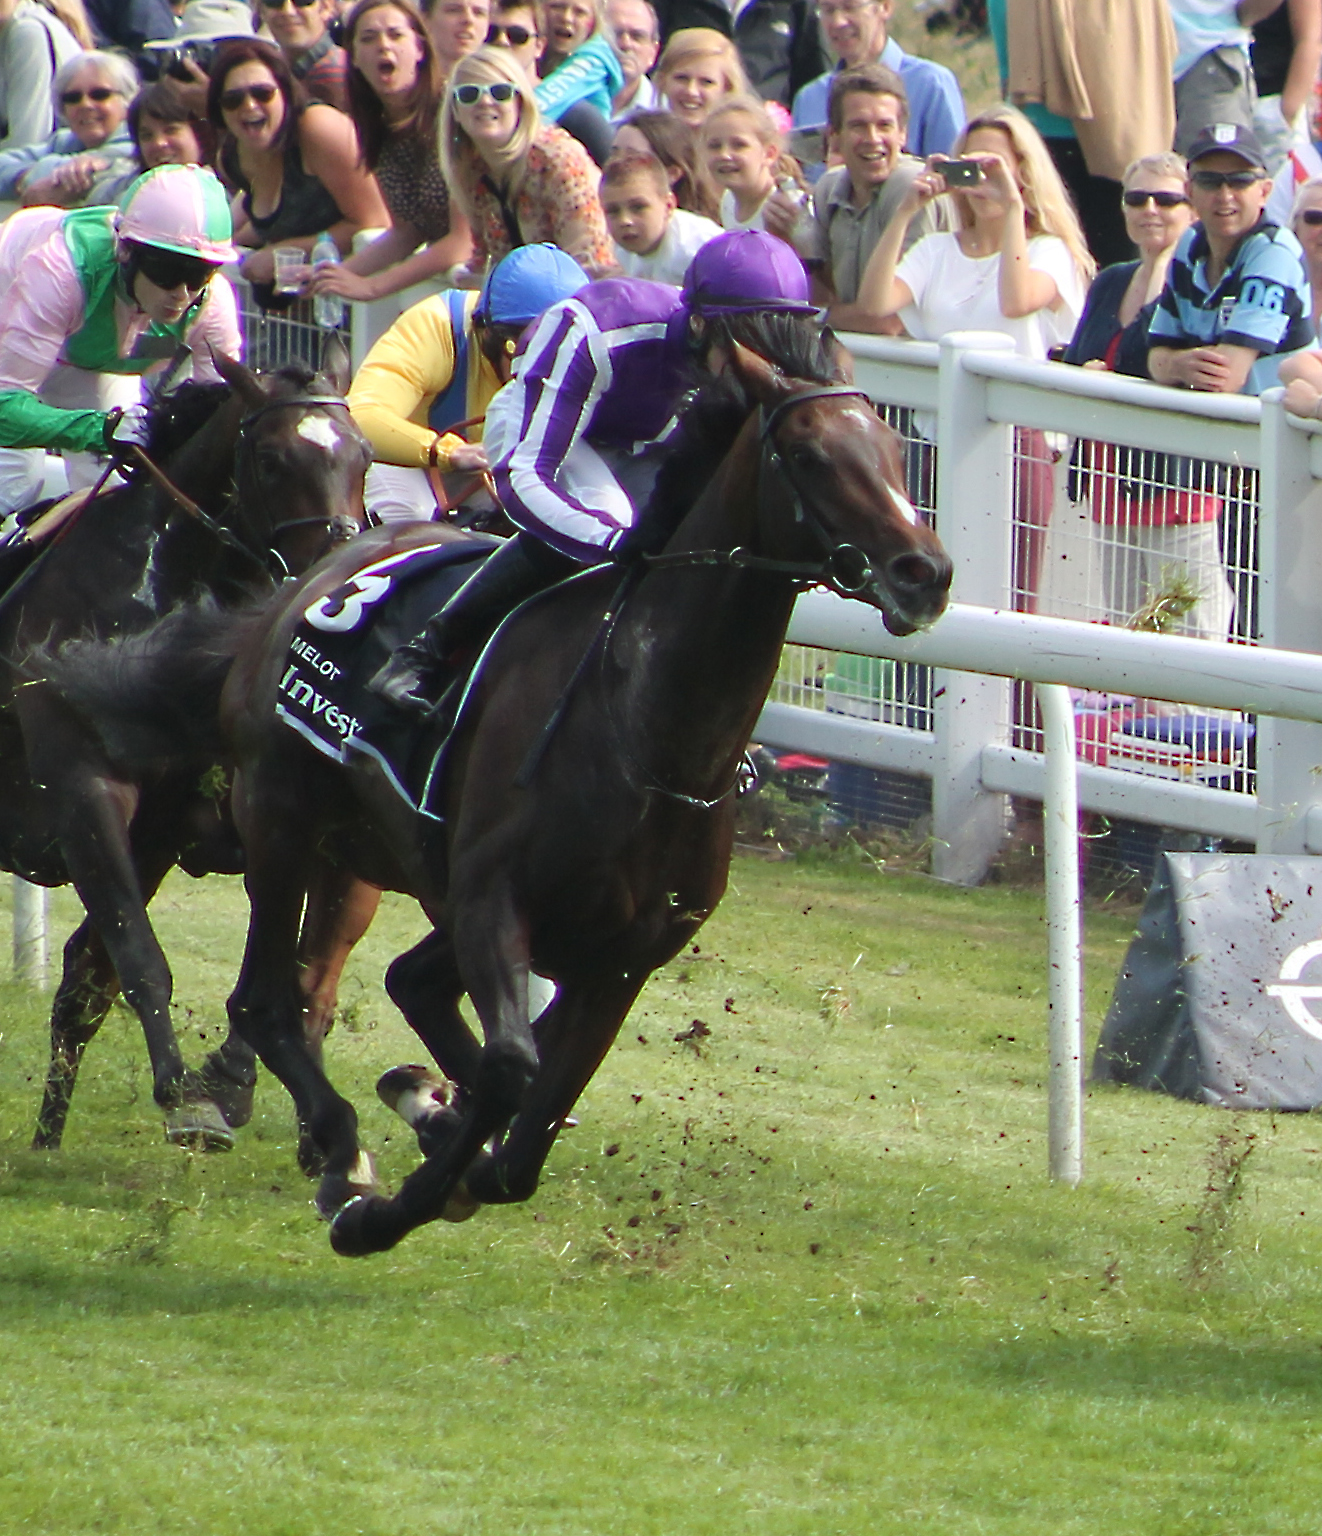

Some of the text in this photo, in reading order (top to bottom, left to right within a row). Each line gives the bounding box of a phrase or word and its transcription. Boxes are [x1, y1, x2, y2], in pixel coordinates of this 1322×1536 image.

[1241, 280, 1285, 315] 06
[304, 575, 391, 632] 3
[289, 636, 341, 681] MELOT
[278, 664, 363, 738] Invest
